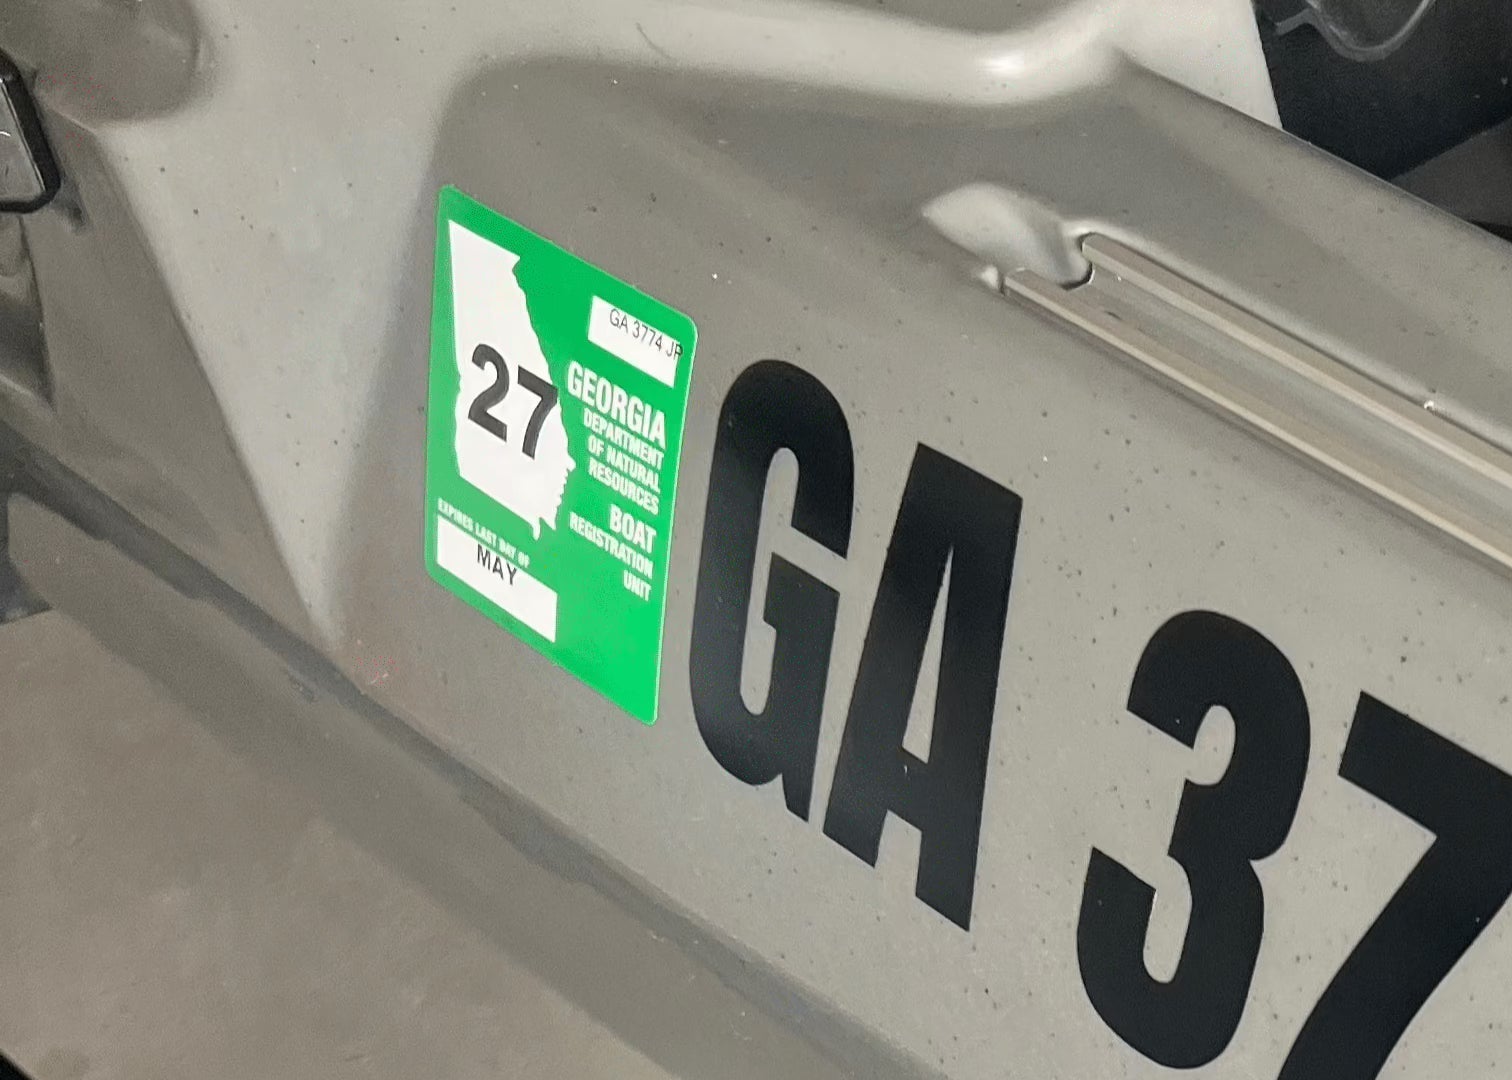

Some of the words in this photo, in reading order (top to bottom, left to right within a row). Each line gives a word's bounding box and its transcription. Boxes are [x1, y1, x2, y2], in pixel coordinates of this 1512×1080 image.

[609, 308, 628, 333] GA
[632, 320, 663, 352] 3774
[467, 342, 559, 460] 27
[568, 360, 666, 449] GEORGIA
[583, 407, 664, 471] DEPARTMENT
[588, 434, 605, 456] OF
[606, 445, 661, 494] NATURAL
[588, 456, 660, 516] RESOURCES
[475, 522, 497, 547] LAST
[569, 511, 654, 579] REGISTRATION
[609, 503, 657, 553] BOAT
[477, 543, 517, 586] MAY
[623, 569, 651, 601] UNIT
[688, 360, 1023, 930] GA
